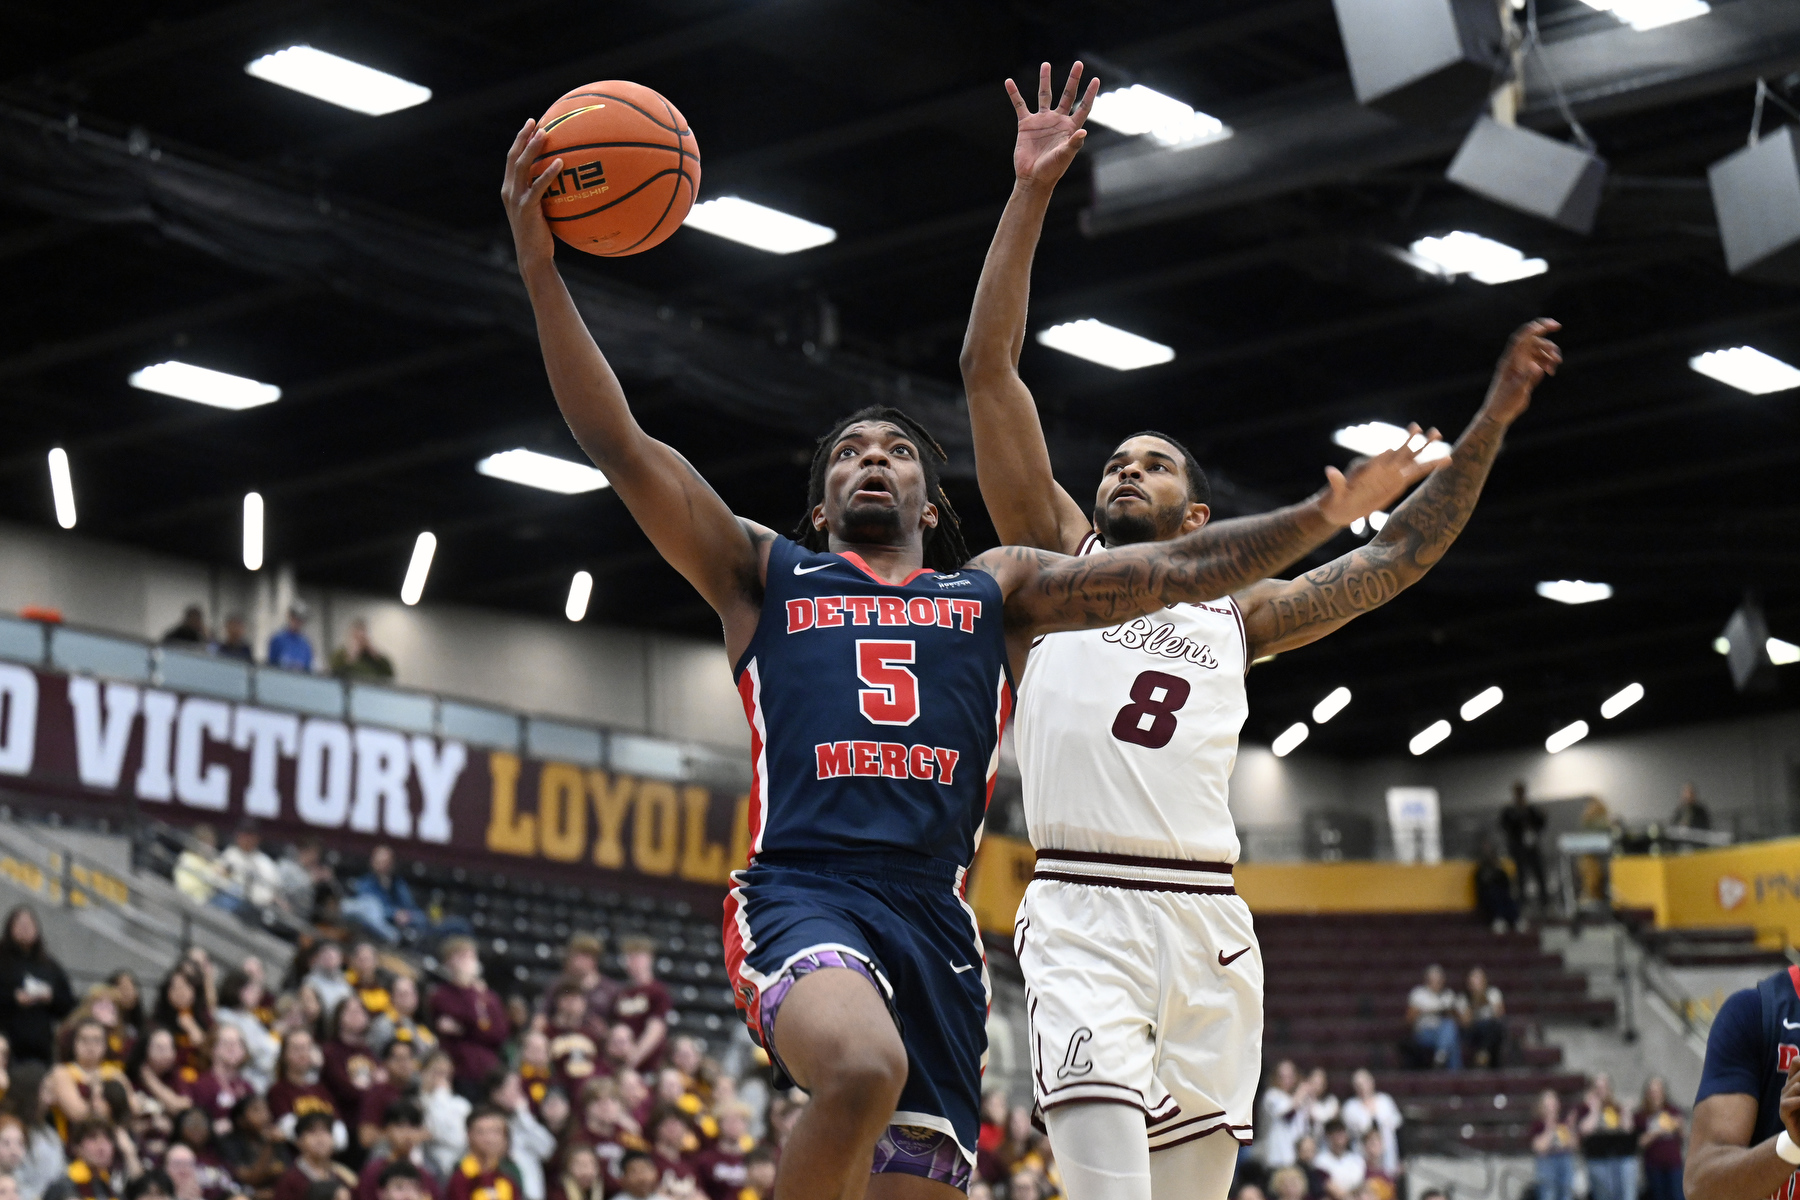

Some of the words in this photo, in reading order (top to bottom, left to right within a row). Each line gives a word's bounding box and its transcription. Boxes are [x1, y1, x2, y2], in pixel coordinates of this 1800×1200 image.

[532, 160, 606, 199] LITE
[785, 595, 982, 634] DETROIT
[1268, 583, 1346, 642] FEAR
[1342, 568, 1399, 611] GOD
[1102, 615, 1219, 669] Blers
[855, 639, 920, 726] 5
[1111, 670, 1191, 749] 8
[67, 674, 467, 844] VICTORY
[815, 741, 959, 785] MERCY
[1057, 1026, 1093, 1079] L
